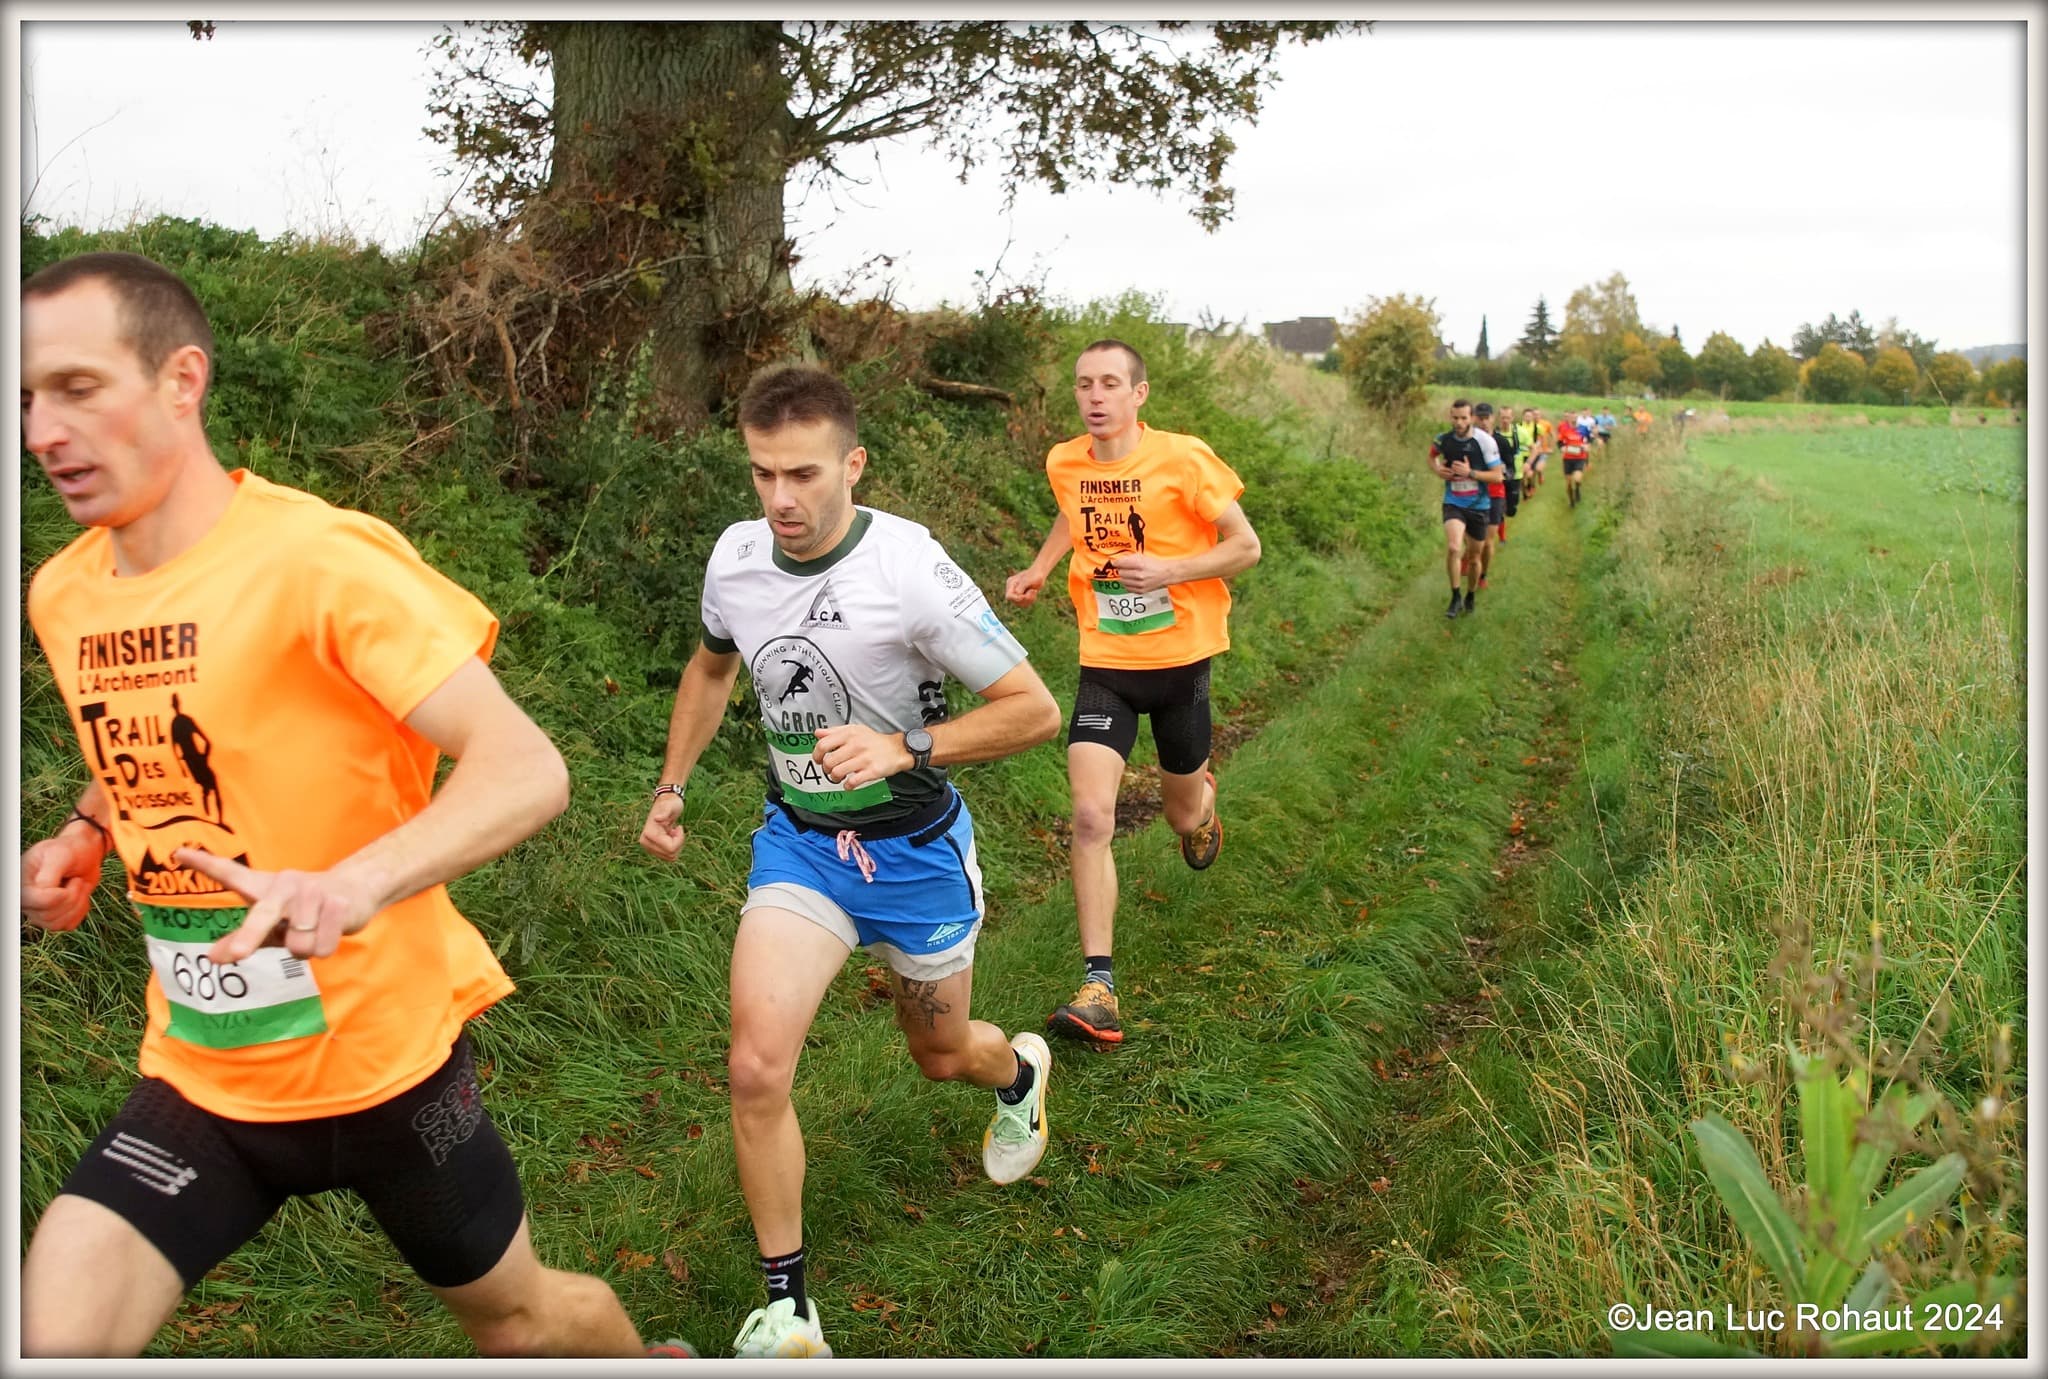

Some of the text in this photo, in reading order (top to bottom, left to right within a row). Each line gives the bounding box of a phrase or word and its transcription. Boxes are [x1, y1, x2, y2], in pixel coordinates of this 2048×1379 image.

[1080, 479, 1142, 495] FINISHER
[1080, 495, 1142, 504] L'Archemont
[809, 609, 842, 623] LCA
[1108, 596, 1146, 617] 685
[78, 622, 199, 671] FINISHER
[756, 645, 787, 675] RUNNING
[791, 644, 837, 689] ATHLETIQUE
[78, 664, 198, 695] L'Archemont
[781, 710, 829, 733] CRAC
[173, 952, 248, 1001] 686
